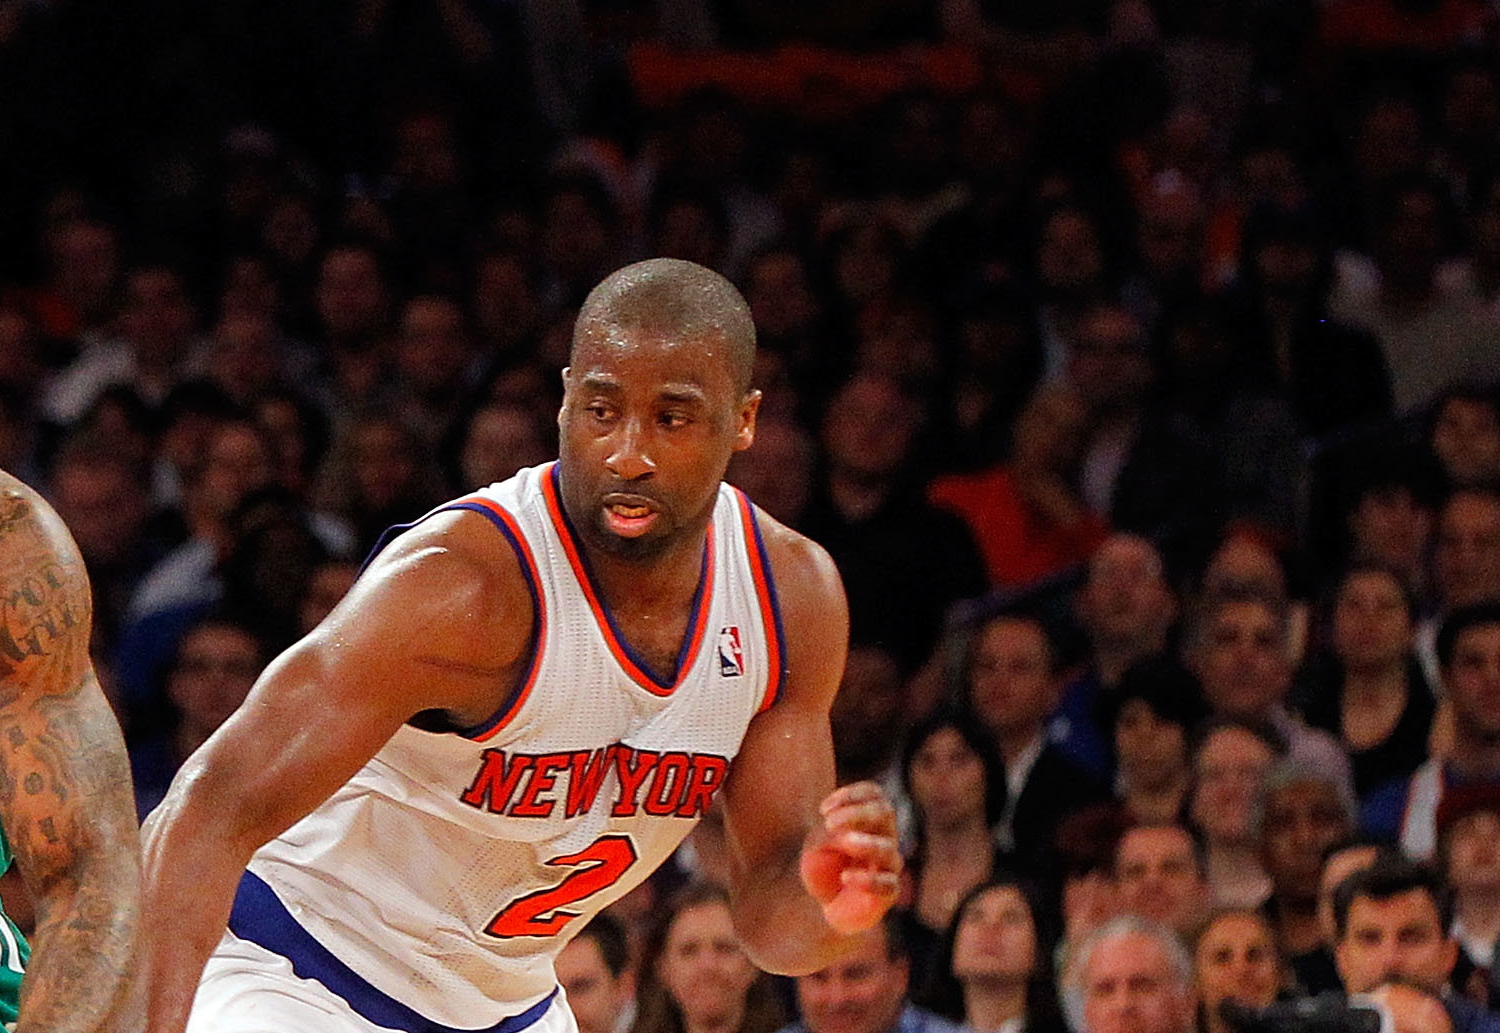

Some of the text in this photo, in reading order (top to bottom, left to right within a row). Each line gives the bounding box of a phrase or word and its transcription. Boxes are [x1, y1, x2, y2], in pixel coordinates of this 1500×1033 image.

[460, 742, 729, 818] NEW YOR
[482, 834, 638, 938] 2
